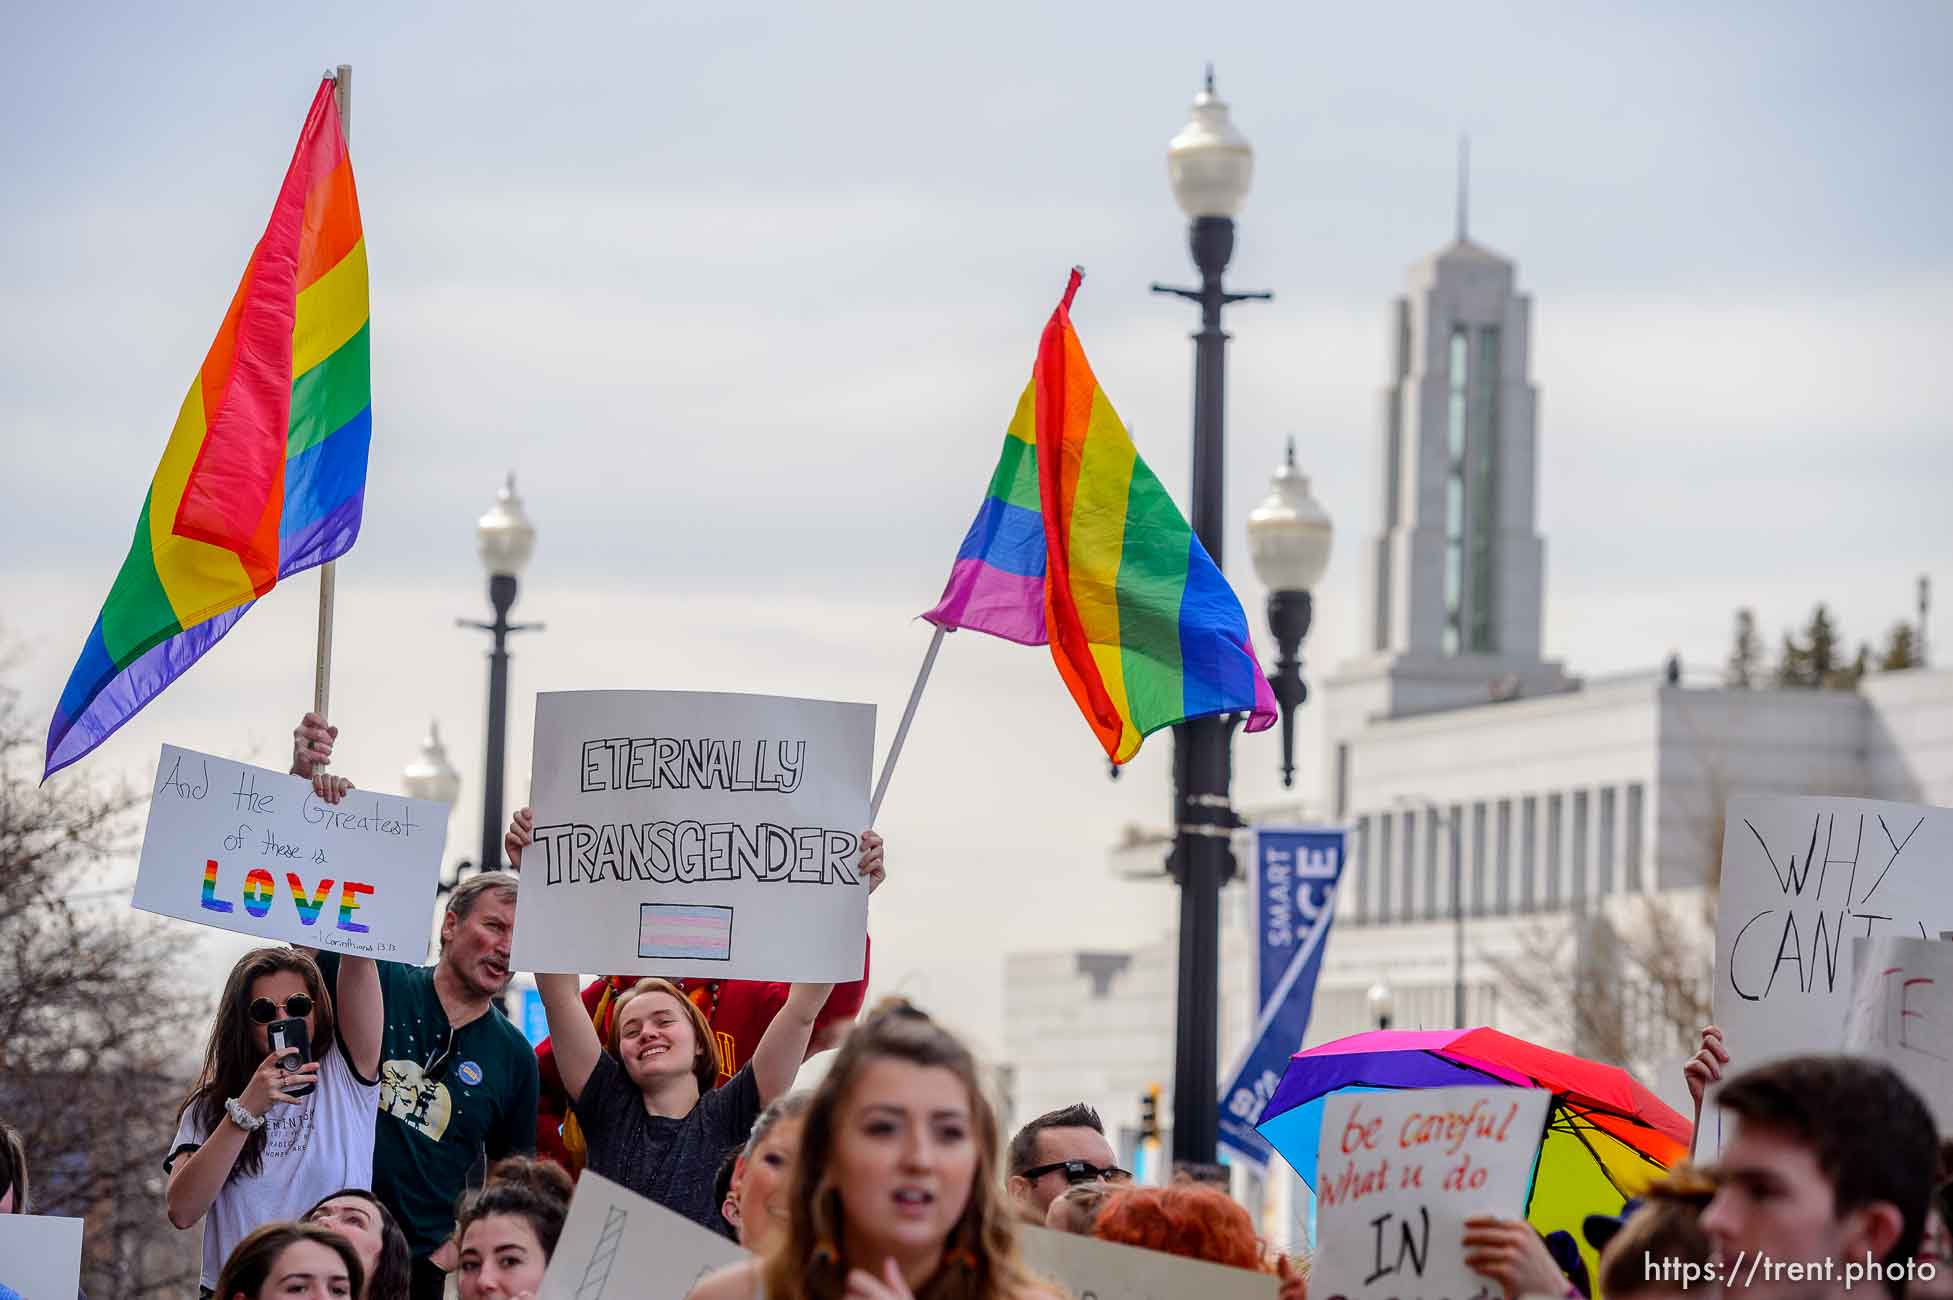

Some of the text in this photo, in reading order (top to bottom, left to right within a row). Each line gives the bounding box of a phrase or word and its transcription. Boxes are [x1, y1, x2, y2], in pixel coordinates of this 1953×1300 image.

[160, 756, 421, 837] And the Greatest
[580, 737, 806, 793] ETERNALLY
[223, 824, 329, 864] of these is
[533, 820, 860, 886] TRANSGENDER
[1744, 813, 1925, 906] WHY
[201, 859, 375, 934] LOVE
[1266, 847, 1291, 947] SMART
[1340, 1098, 1519, 1156] be careful
[1443, 1153, 1488, 1192] do
[1364, 1205, 1430, 1286] IN
